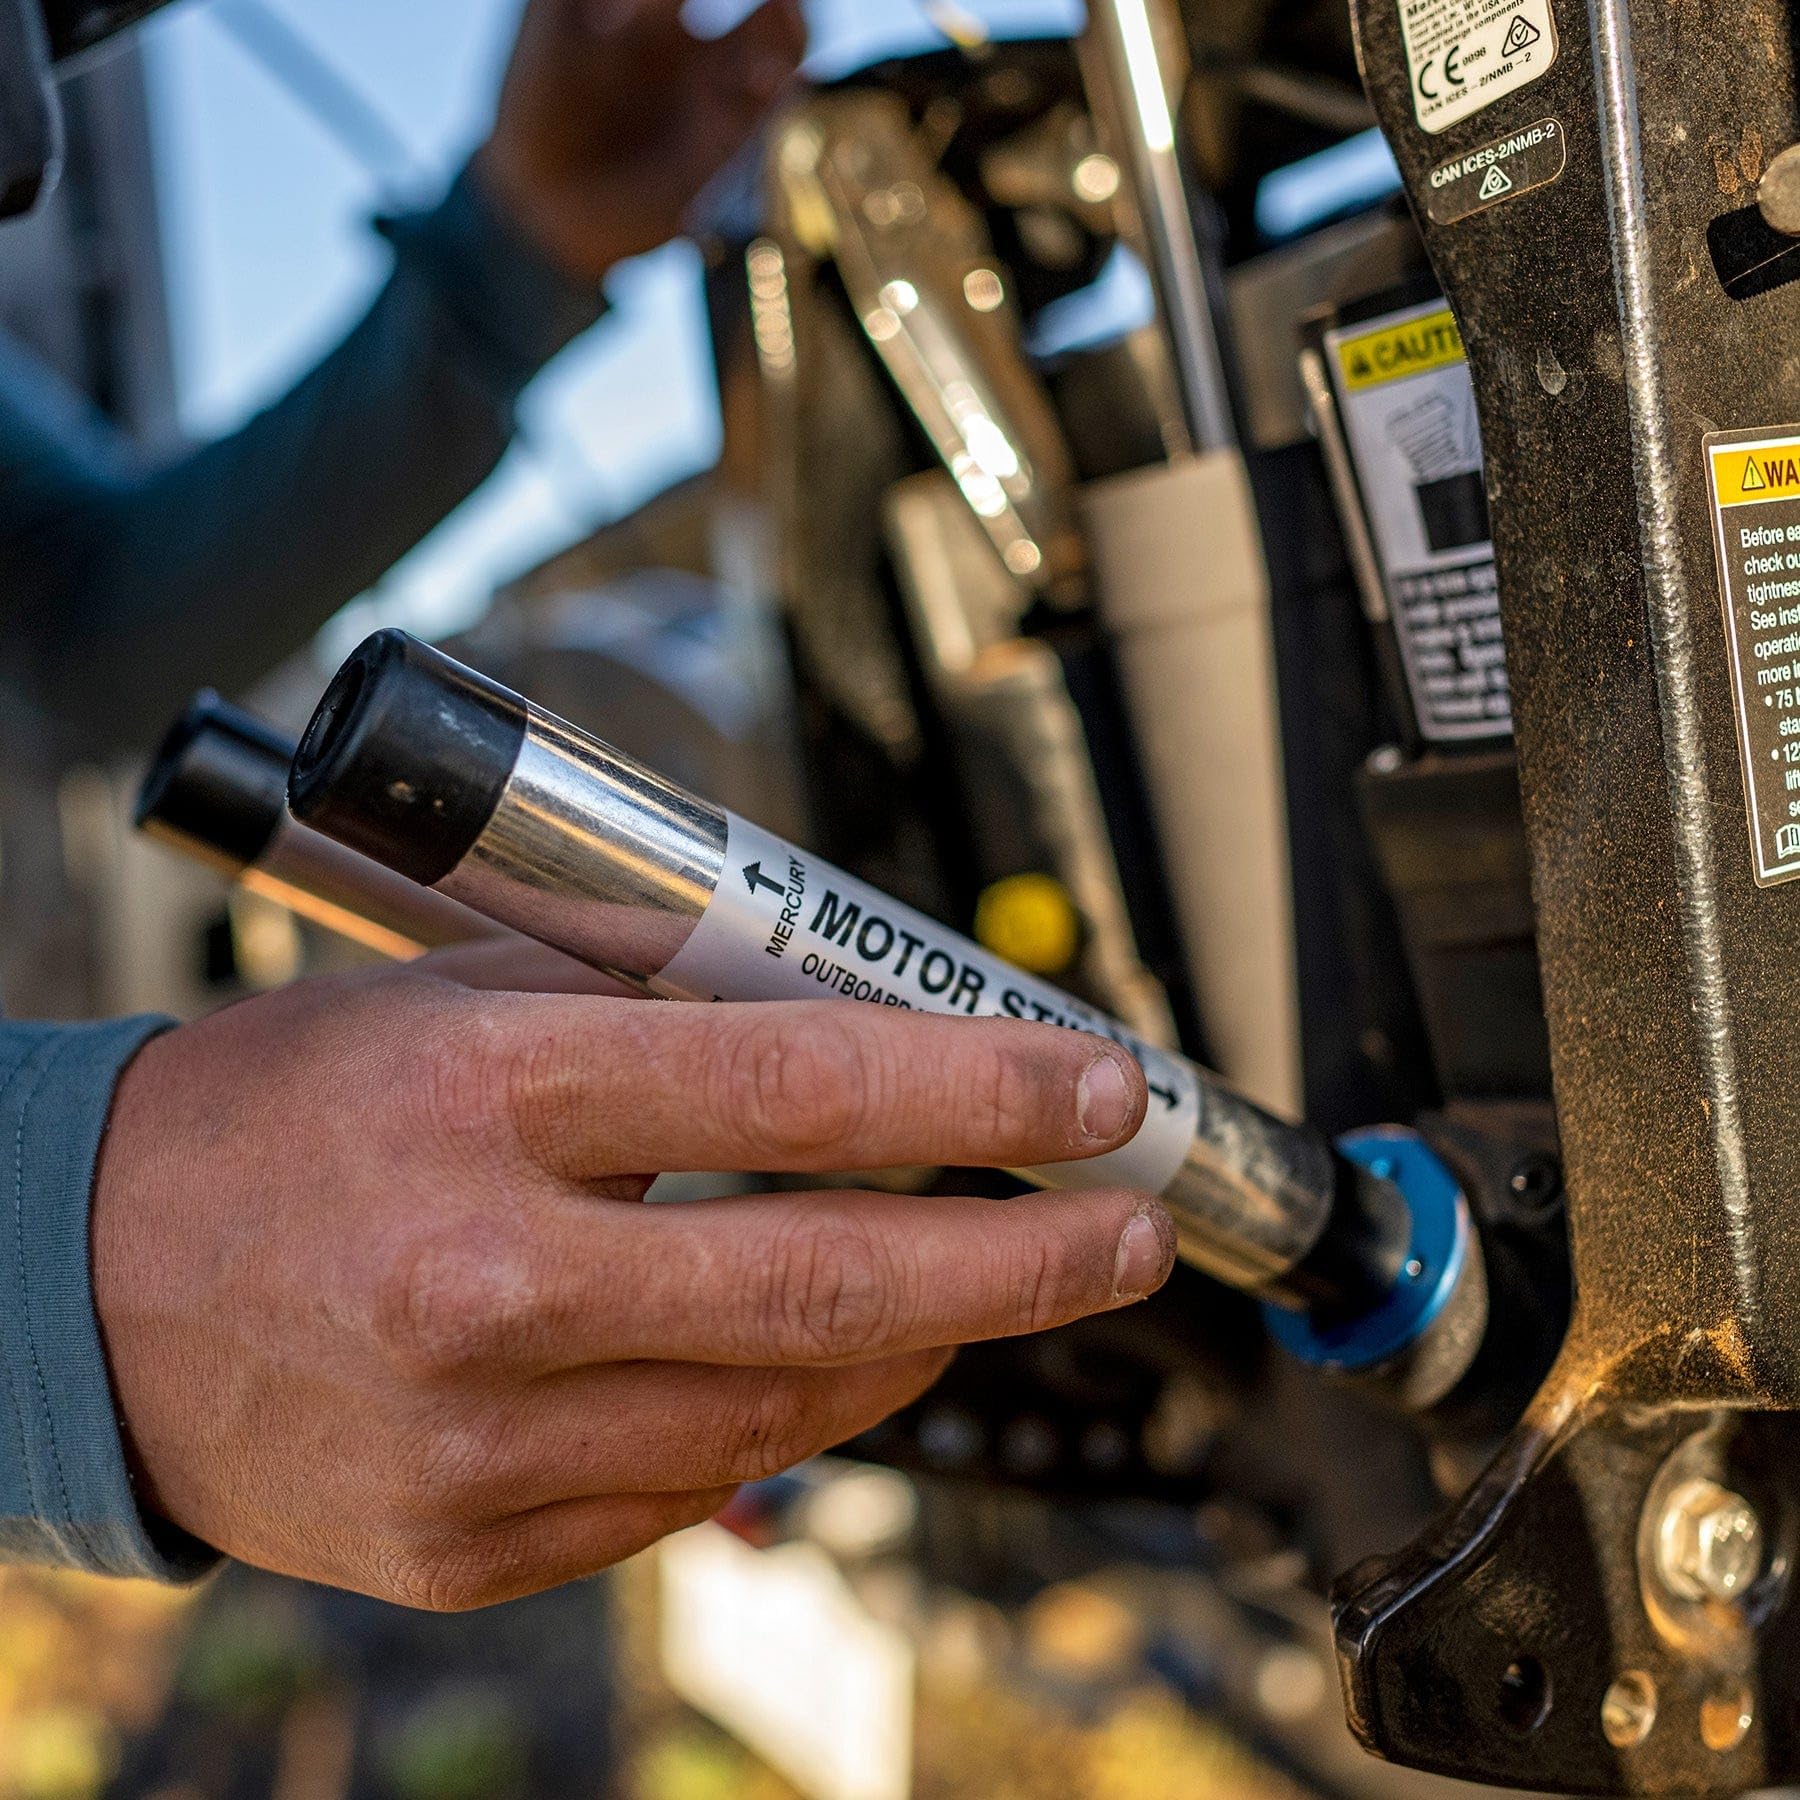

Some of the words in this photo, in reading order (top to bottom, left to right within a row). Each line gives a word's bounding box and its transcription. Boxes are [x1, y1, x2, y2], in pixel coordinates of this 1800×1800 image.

[1474, 0, 1524, 30] components
[1462, 47, 1487, 66] 0098
[1430, 162, 1461, 188] CAN
[1462, 123, 1556, 175] ICES-2/NMB-2
[1763, 458, 1800, 488] WA
[1740, 526, 1784, 548] Before
[1744, 552, 1784, 576] check
[1750, 610, 1777, 631] See
[1754, 631, 1800, 660] operati
[1757, 665, 1791, 685] more
[1775, 688, 1794, 709] 75
[765, 854, 807, 959] MERCURY
[808, 888, 986, 1015] MOTOR
